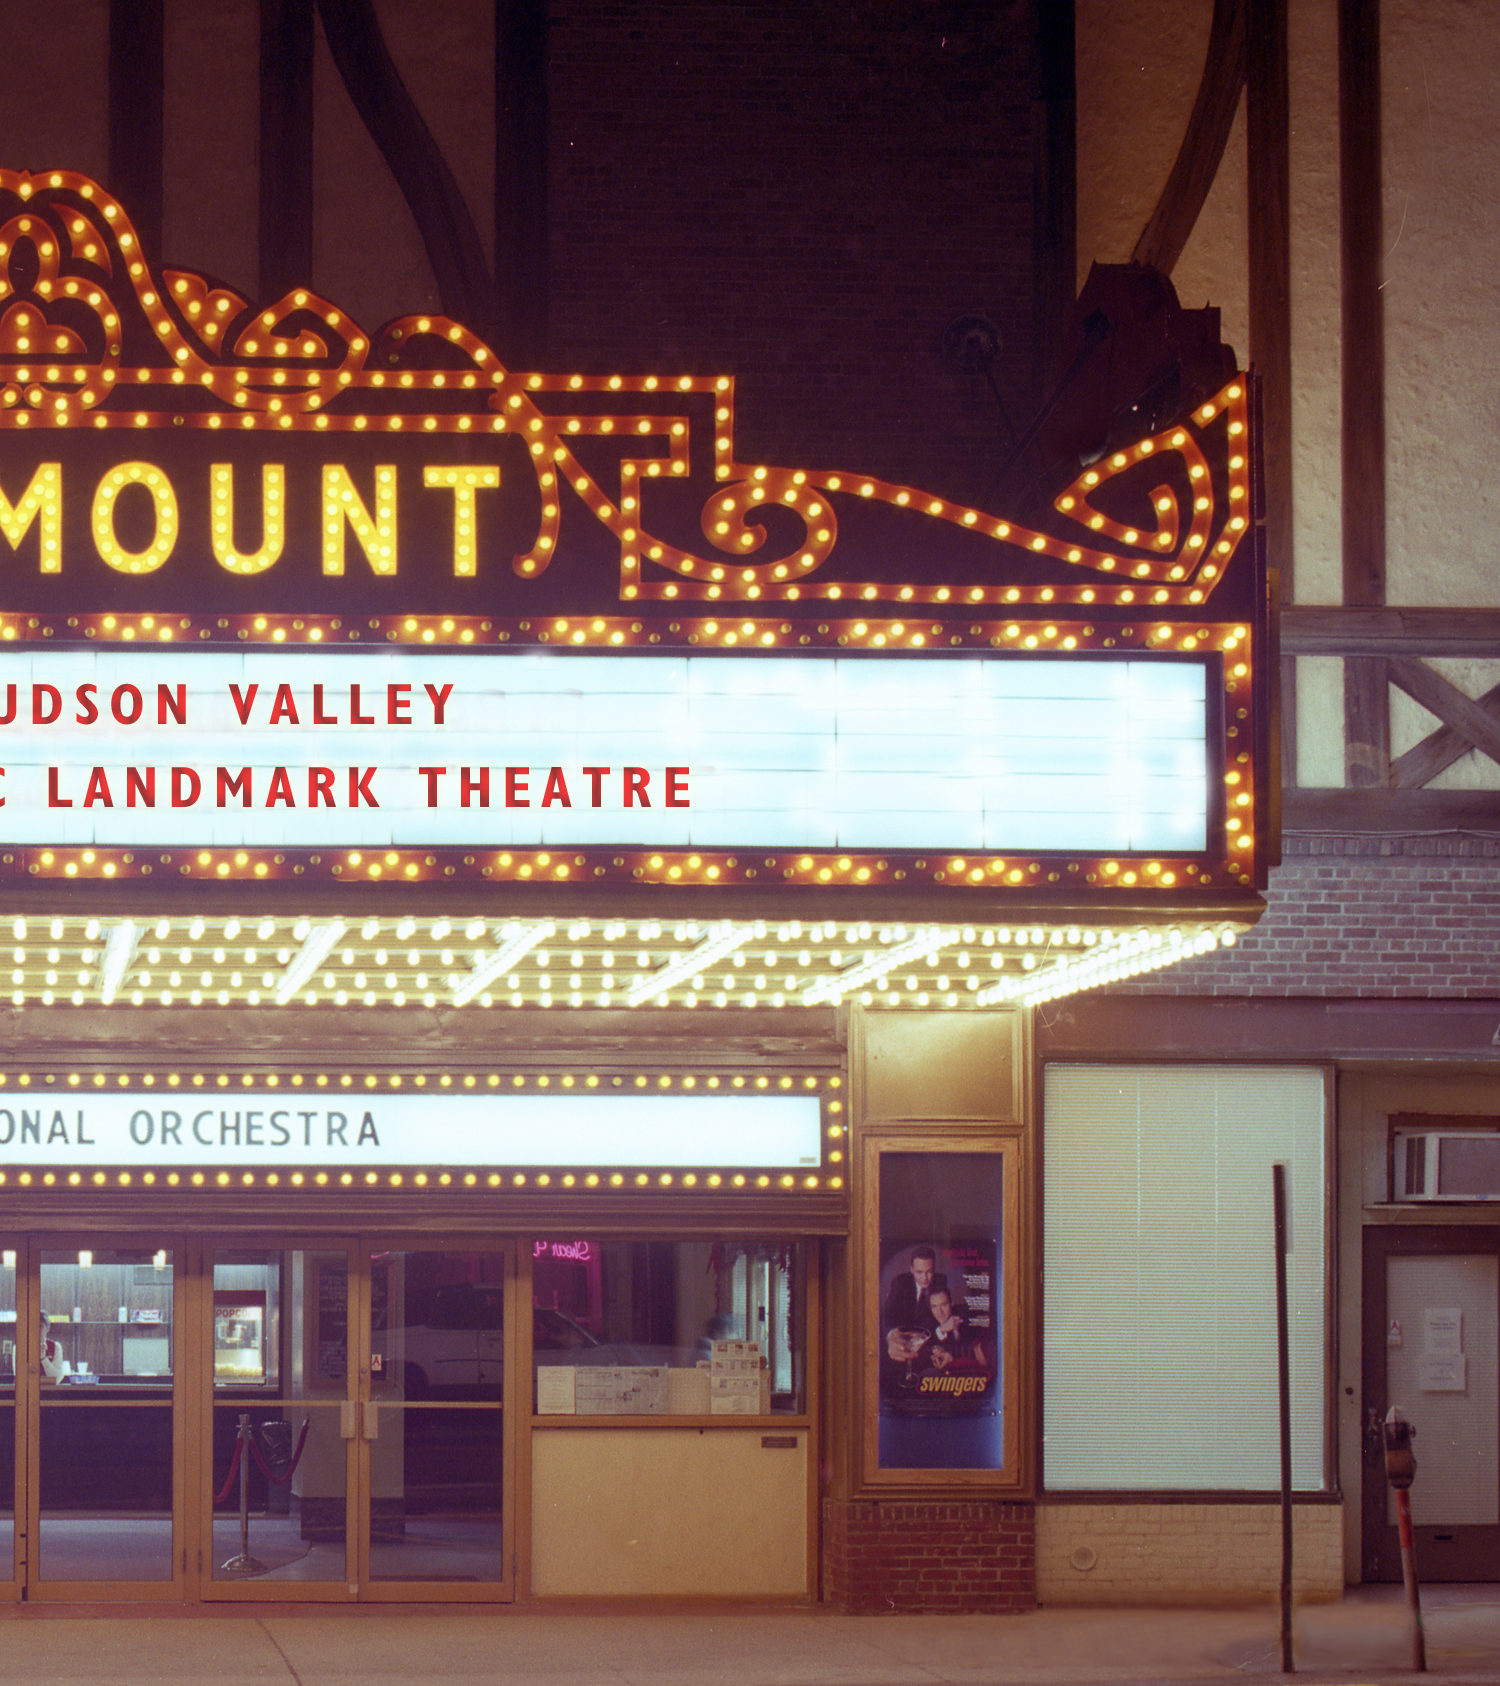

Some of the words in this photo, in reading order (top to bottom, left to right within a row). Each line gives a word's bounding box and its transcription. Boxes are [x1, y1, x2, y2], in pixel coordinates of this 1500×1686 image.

[229, 683, 454, 725] VALLEY
[48, 766, 379, 808] LANDMARK
[418, 766, 690, 808] THEATRE
[131, 1110, 381, 1147] ORCHESTRA
[920, 1375, 987, 1397] swingers
